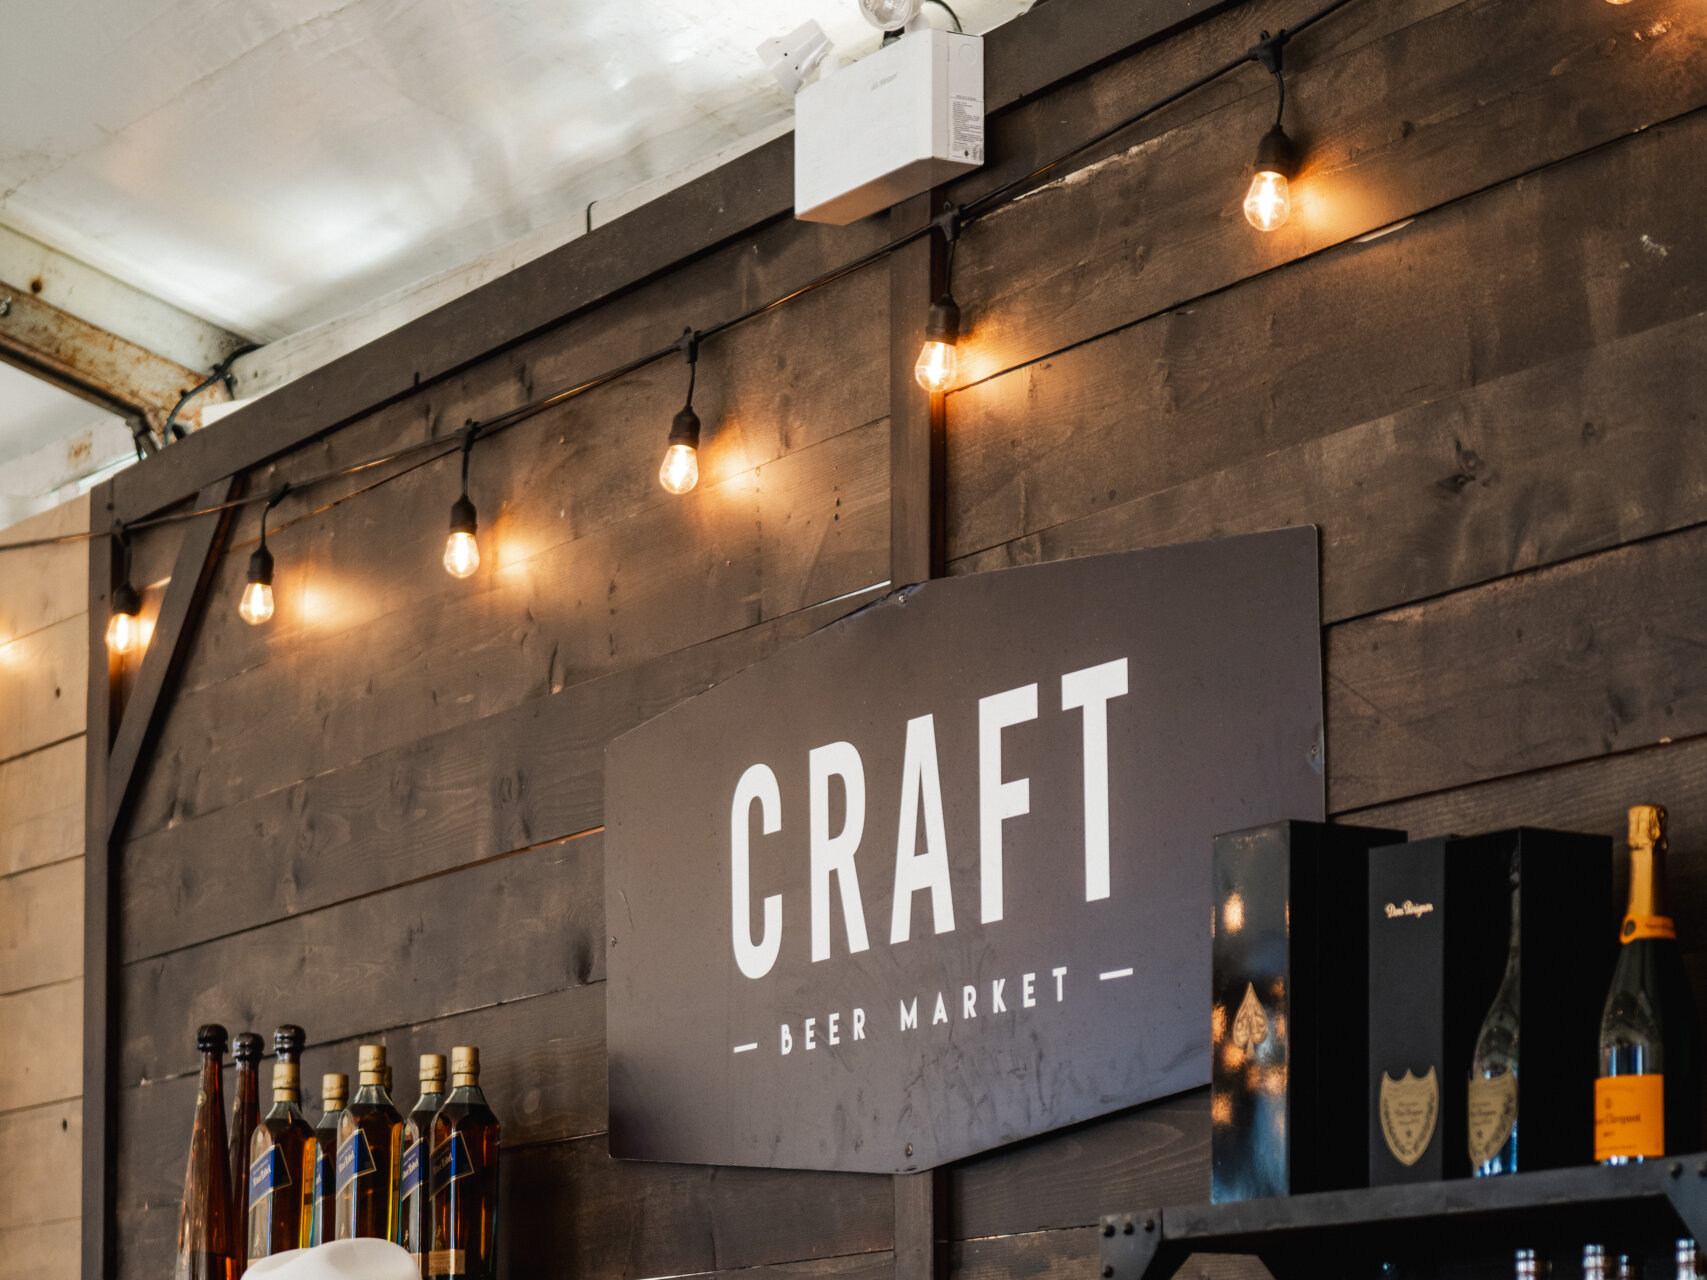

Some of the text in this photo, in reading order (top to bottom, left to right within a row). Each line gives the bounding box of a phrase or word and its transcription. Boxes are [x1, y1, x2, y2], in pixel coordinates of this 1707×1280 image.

[731, 657, 1128, 979] CRAFT
[781, 966, 1068, 1055] BEER MARKET
